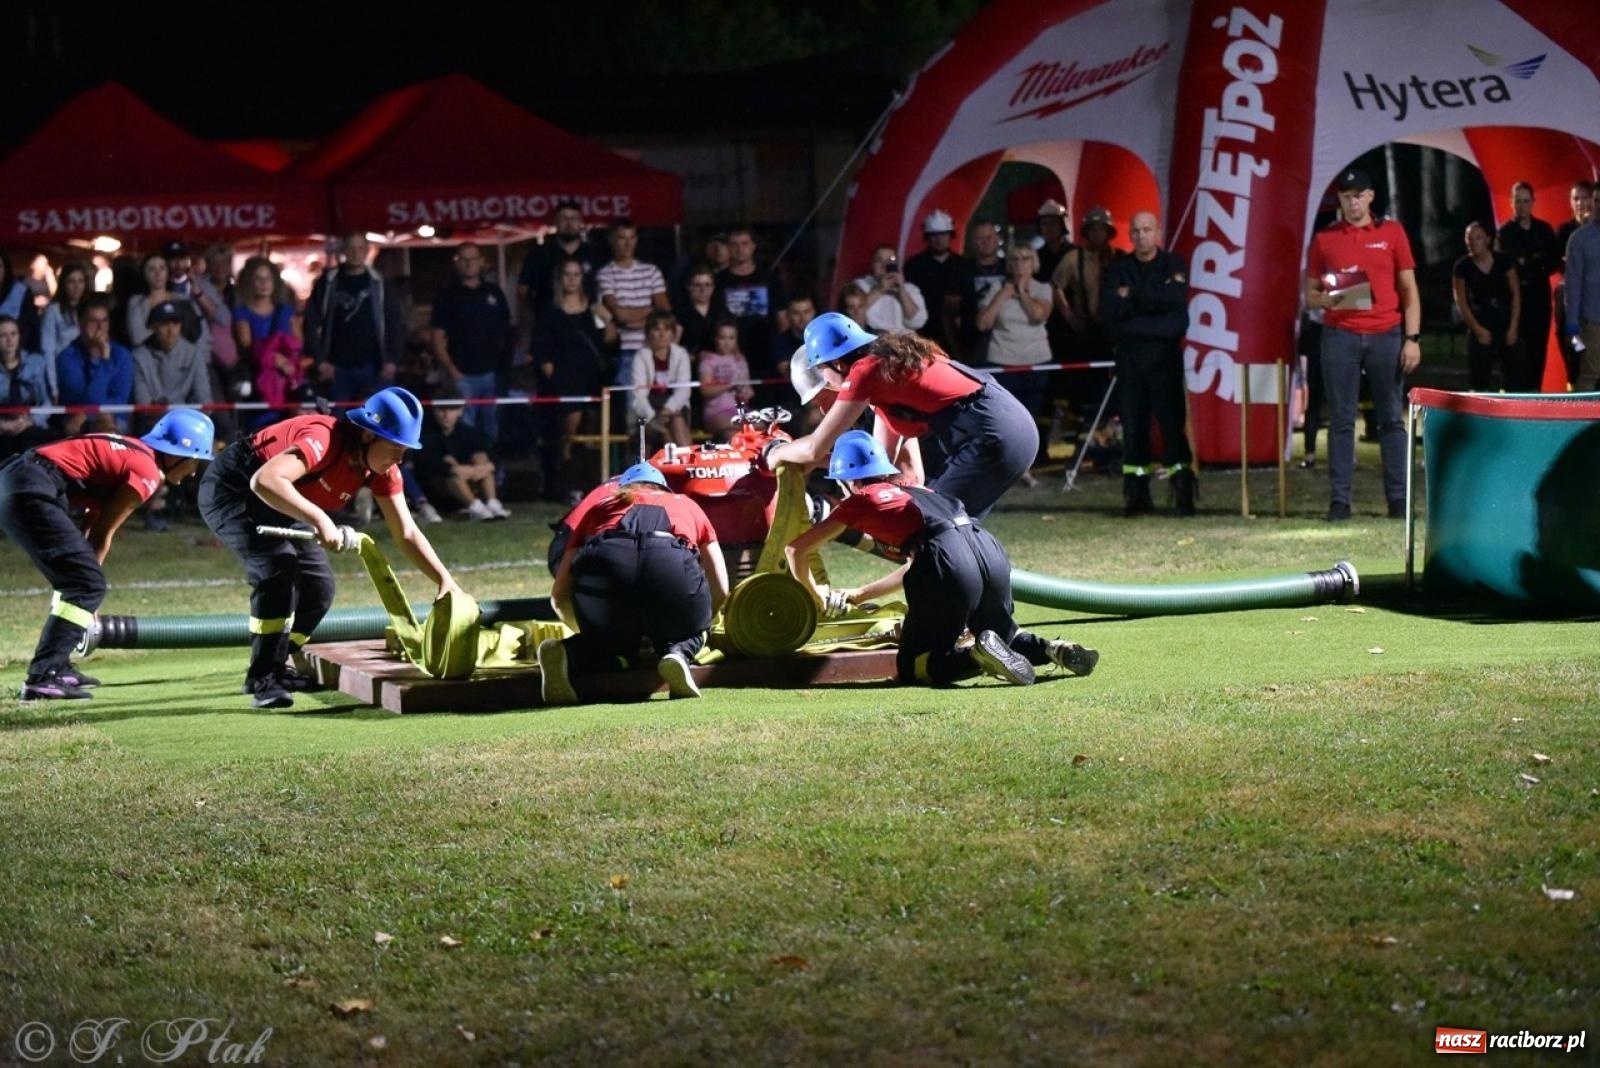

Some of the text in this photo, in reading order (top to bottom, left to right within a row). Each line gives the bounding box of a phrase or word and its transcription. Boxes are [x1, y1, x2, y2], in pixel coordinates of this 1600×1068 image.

[1008, 42, 1170, 107] Milwaukee
[1343, 71, 1512, 121] Hytera
[17, 204, 276, 233] SAMBOROWICE
